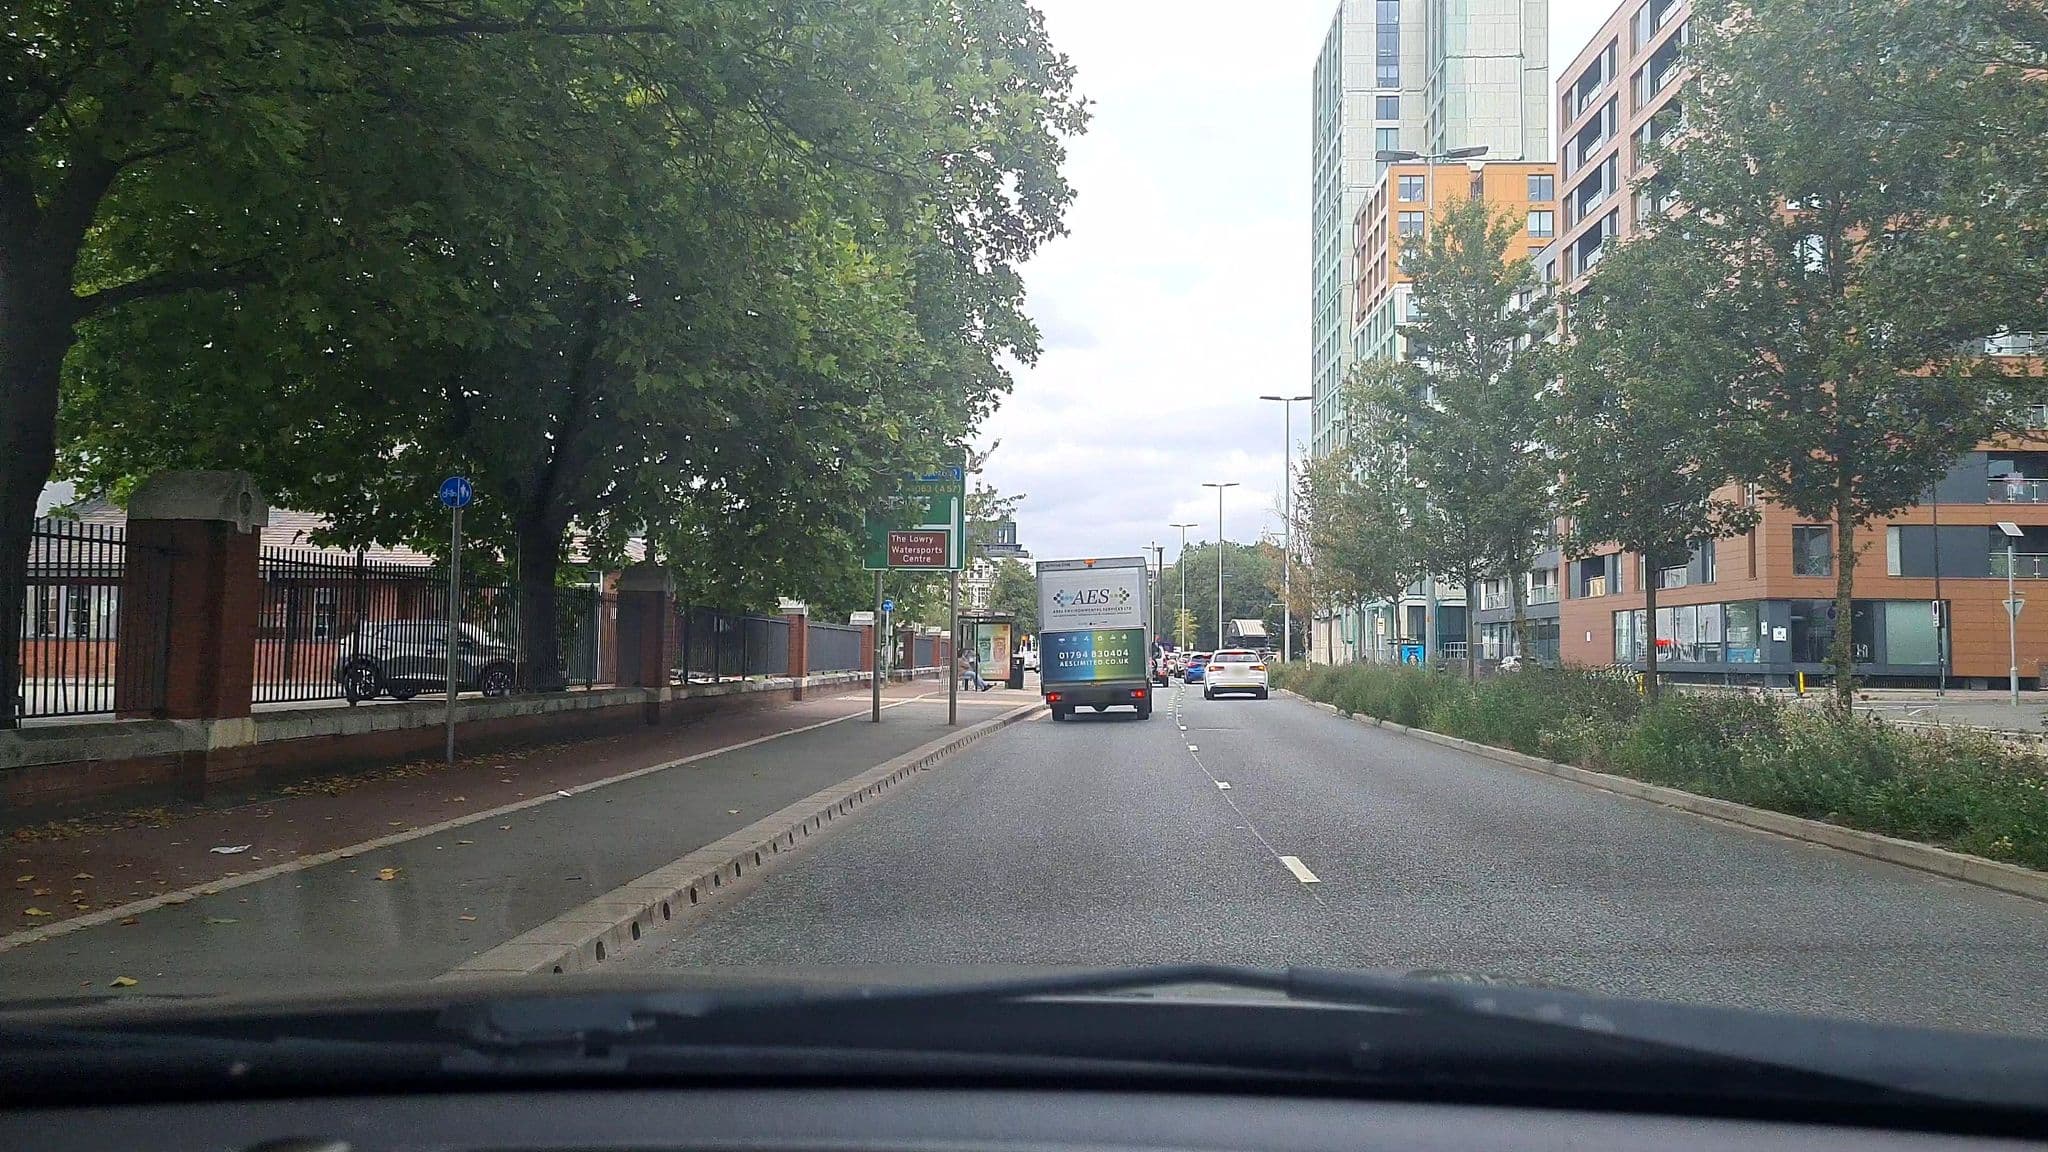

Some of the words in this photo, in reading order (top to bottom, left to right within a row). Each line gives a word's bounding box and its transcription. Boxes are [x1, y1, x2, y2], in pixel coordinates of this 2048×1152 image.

[891, 534, 907, 543] The
[909, 534, 934, 544] Lowry
[891, 545, 943, 555] Watersports
[902, 555, 931, 563] Centre
[1071, 588, 1110, 605] AES
[1059, 651, 1088, 659] 01794
[1091, 648, 1129, 658] 830404
